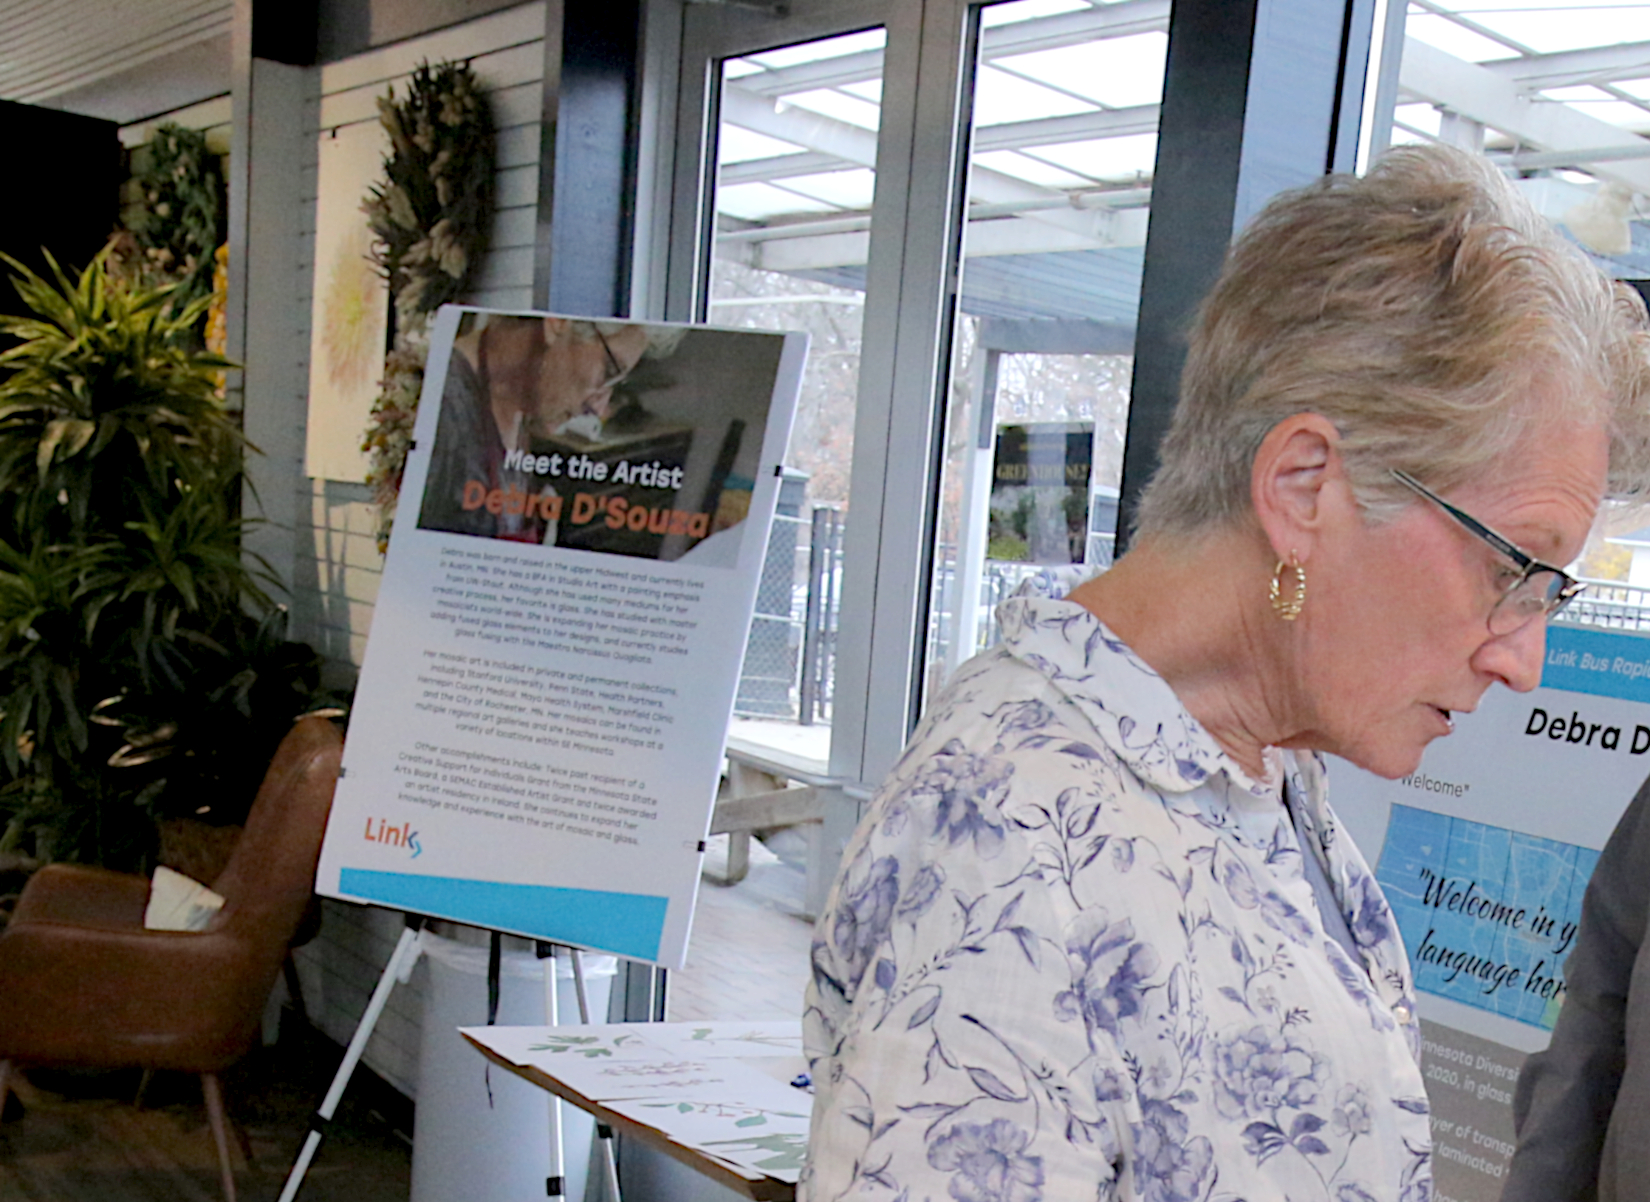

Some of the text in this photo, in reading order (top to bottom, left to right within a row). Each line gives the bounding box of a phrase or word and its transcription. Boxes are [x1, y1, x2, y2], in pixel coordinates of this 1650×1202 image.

[503, 449, 685, 489] Meet the Artist
[461, 479, 710, 538] Debra D'Souza
[1547, 649, 1578, 668] Link
[1580, 652, 1609, 672] Bus
[1525, 707, 1621, 751] Debra
[364, 817, 418, 850] Link
[1419, 868, 1525, 928] "Welcome
[1531, 906, 1555, 938] in
[1416, 929, 1520, 994] language
[1426, 1063, 1513, 1105] 2020, in glass
[1455, 1125, 1472, 1139] of
[1438, 1141, 1504, 1178] laminated
